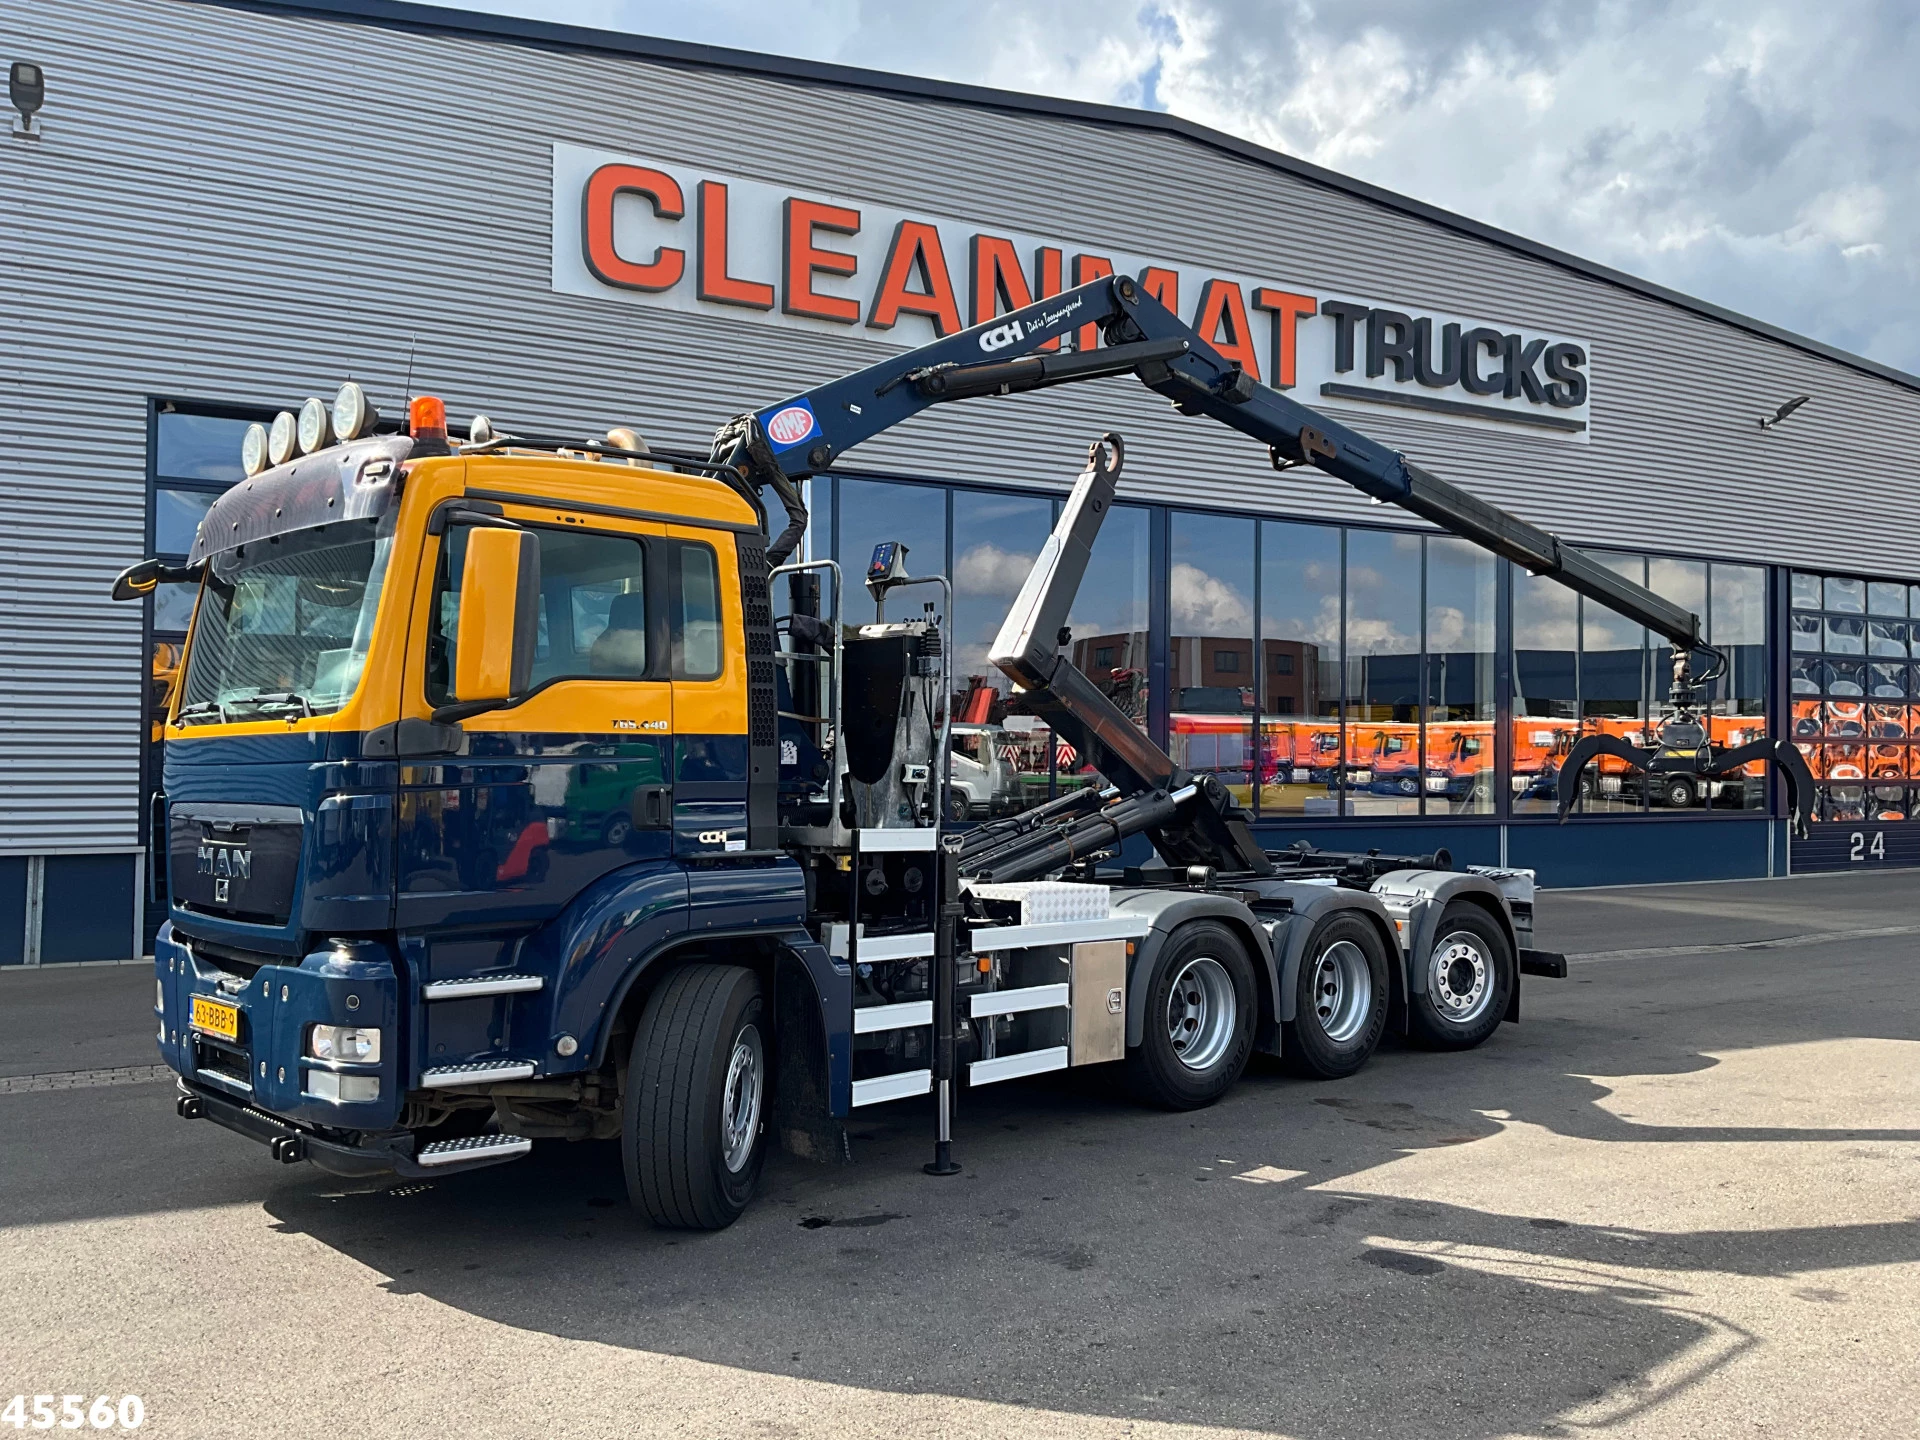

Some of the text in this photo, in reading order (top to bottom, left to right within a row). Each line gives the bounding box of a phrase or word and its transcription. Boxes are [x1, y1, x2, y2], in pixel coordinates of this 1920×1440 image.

[979, 320, 1025, 352] CCH
[1321, 300, 1587, 408] TRUCKS
[773, 411, 806, 440] HMF
[698, 830, 727, 843] CCH
[1850, 831, 1886, 861] 24
[197, 846, 252, 879] MAN
[196, 1003, 235, 1031] 63-BBB-9
